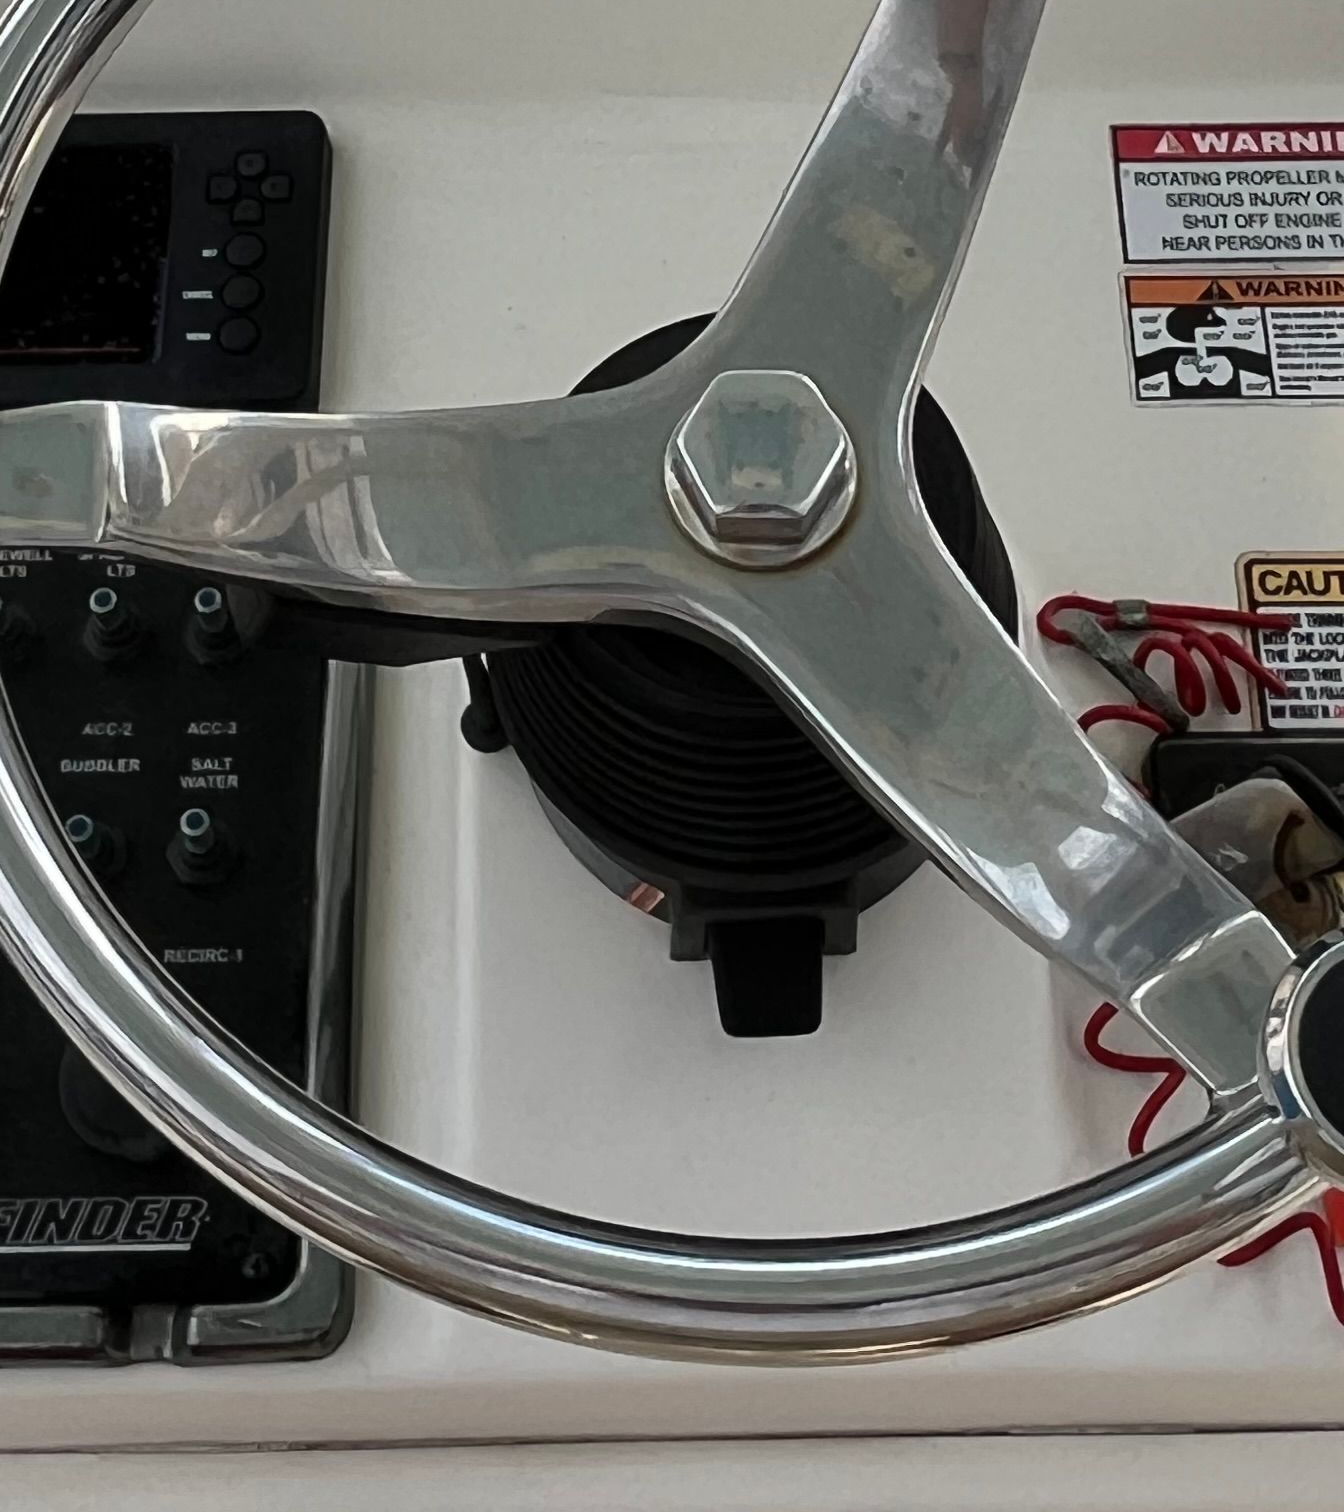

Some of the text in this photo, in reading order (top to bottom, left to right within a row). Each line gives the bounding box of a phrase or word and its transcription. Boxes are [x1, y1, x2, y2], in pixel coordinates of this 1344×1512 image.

[1134, 171, 1222, 187] ROTATING
[1225, 170, 1330, 186] PROPELLER
[1165, 191, 1245, 208] SERIOUS
[1249, 191, 1311, 207] INJURY
[1315, 191, 1343, 207] OR
[1182, 213, 1228, 229] SHUT
[1234, 213, 1269, 228] OFF
[1274, 212, 1342, 228] ENGINE
[1161, 235, 1212, 251] NEAR
[1214, 234, 1302, 251] PERSONS
[1306, 234, 1325, 249] IN
[81, 721, 135, 736] ACC-2
[186, 721, 238, 735] ACC-3
[191, 757, 233, 771] SALT
[179, 774, 239, 789] WATER
[163, 948, 244, 964] RECIRC-1
